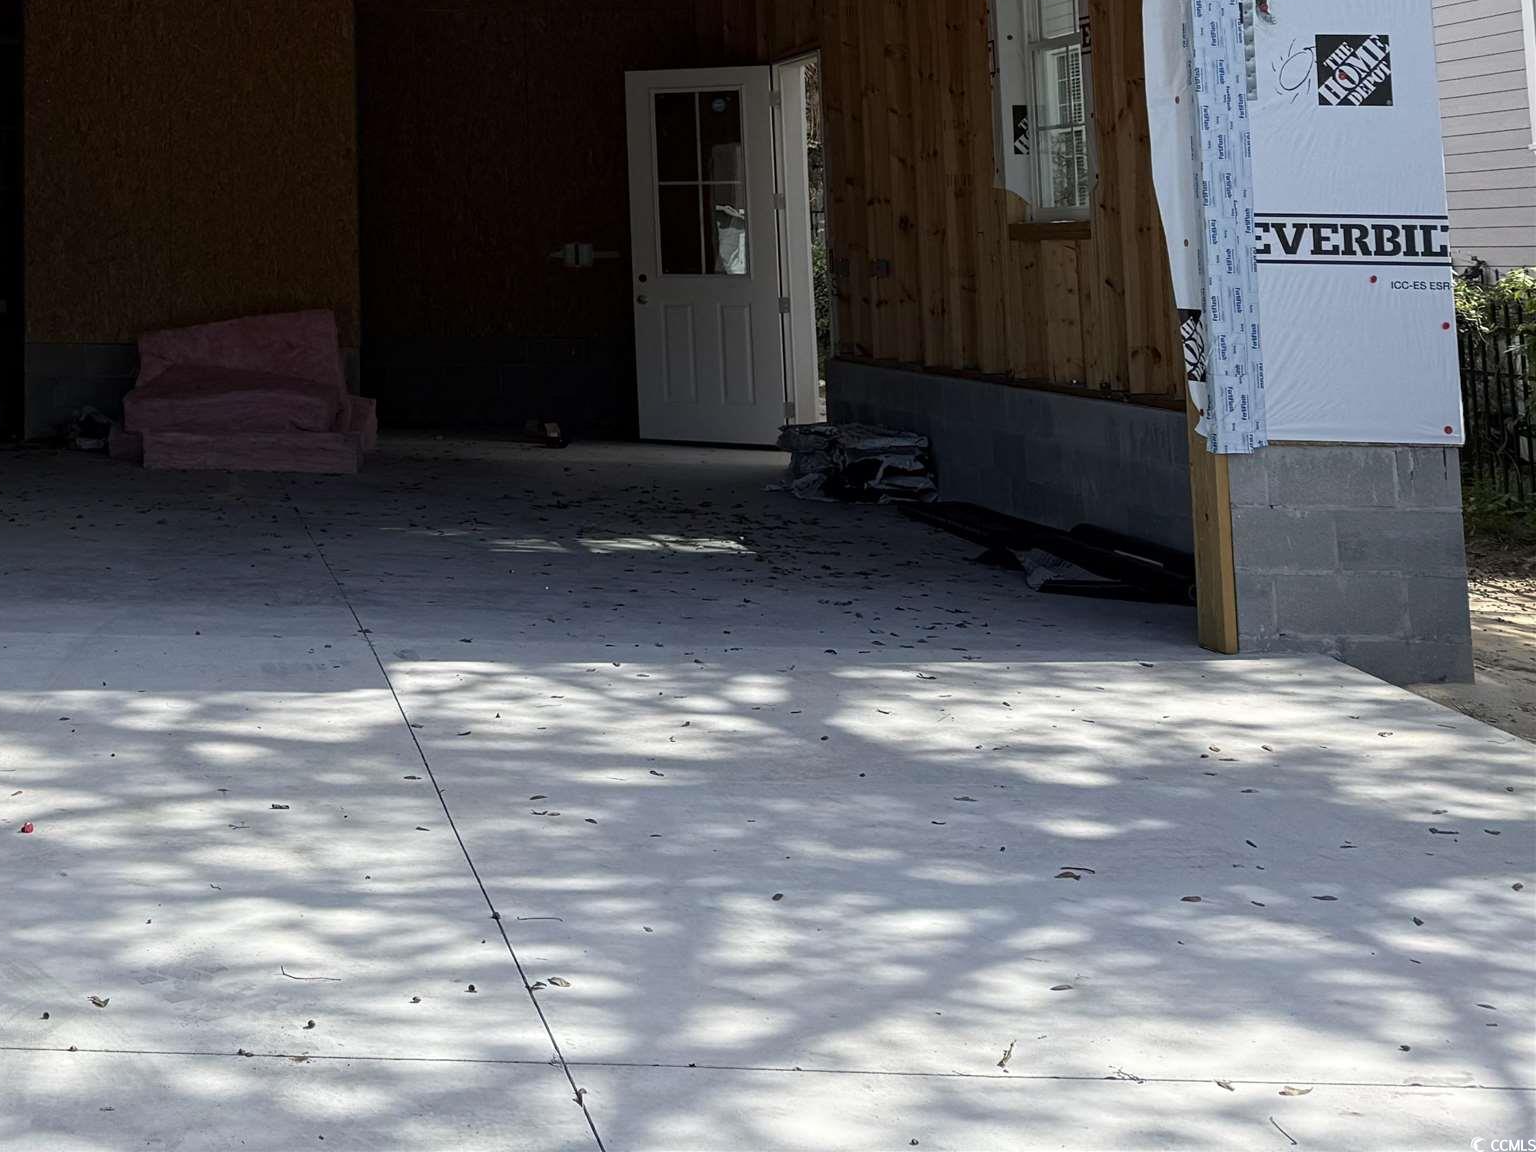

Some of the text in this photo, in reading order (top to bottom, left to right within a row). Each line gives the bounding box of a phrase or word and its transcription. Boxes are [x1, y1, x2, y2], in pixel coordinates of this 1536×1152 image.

[1317, 34, 1391, 106] HOME
[1324, 41, 1354, 70] THE
[1346, 59, 1393, 106] DEPOT
[1391, 280, 1427, 291] ICC-ES
